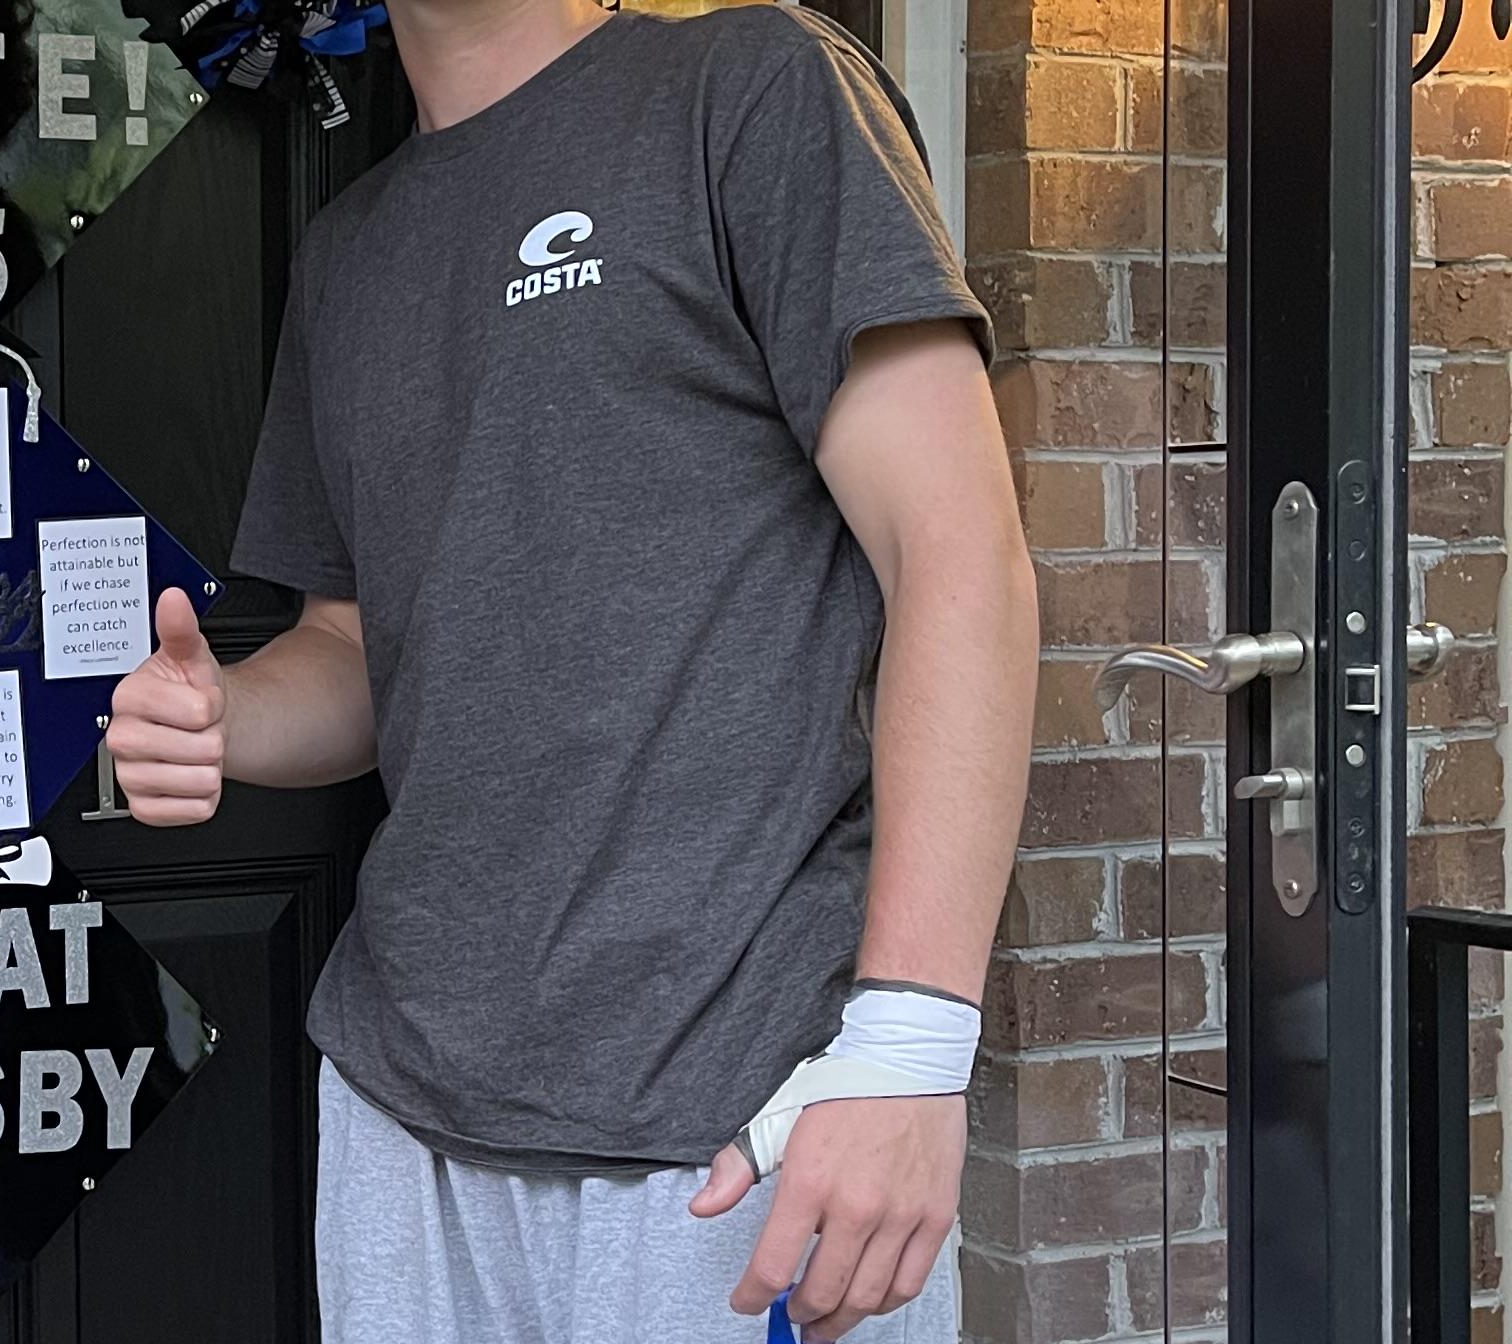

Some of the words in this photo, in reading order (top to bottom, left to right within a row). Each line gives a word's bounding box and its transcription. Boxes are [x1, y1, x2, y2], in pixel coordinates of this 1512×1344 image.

[506, 259, 603, 307] COSTA
[41, 537, 107, 551] Perfection
[110, 535, 121, 547] is
[124, 534, 145, 546] not
[49, 556, 114, 572] attainable
[117, 555, 139, 568] but
[60, 578, 68, 592] if
[72, 580, 91, 591] we
[94, 578, 131, 590] chase
[52, 598, 117, 616] perfection
[121, 597, 141, 609] we
[67, 622, 89, 634] can
[93, 618, 127, 631] catch
[3, 688, 13, 701] is
[5, 751, 18, 763] to
